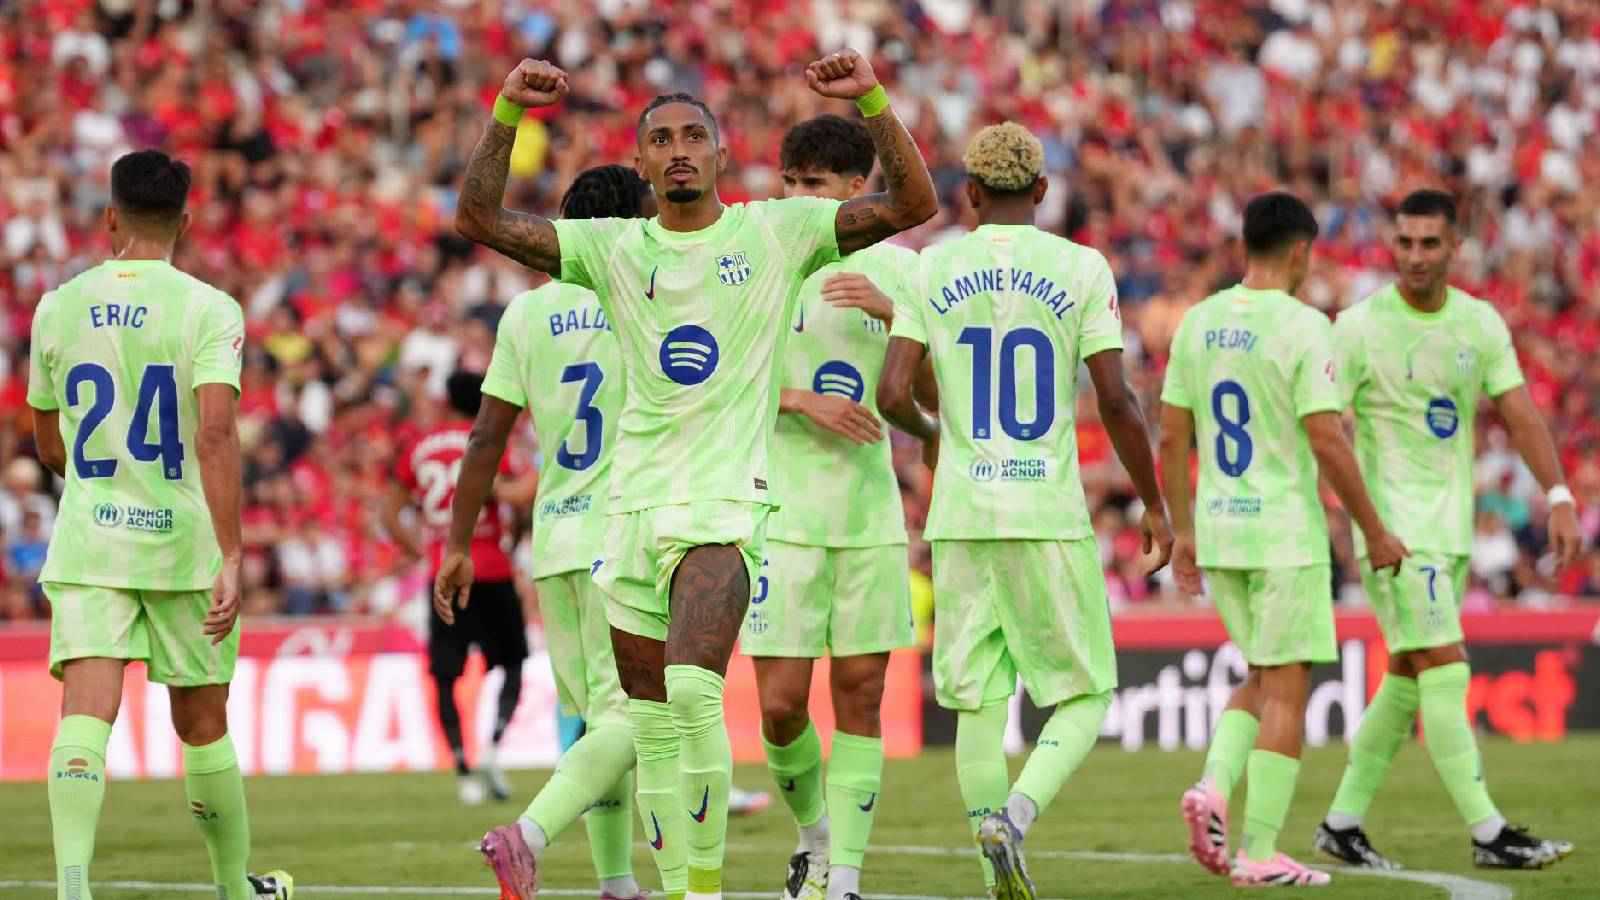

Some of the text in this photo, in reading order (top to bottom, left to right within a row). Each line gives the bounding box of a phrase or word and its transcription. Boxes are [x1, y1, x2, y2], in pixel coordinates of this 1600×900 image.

[90, 303, 148, 329] ERIC
[929, 267, 1075, 320] LAMINE YAMAL
[550, 307, 612, 337] BALD
[1205, 328, 1258, 352] PEDRI
[957, 327, 1055, 441] 10
[65, 363, 184, 480] 24
[556, 361, 605, 471] 3
[1211, 379, 1254, 478] 8
[1418, 565, 1436, 602] 7
